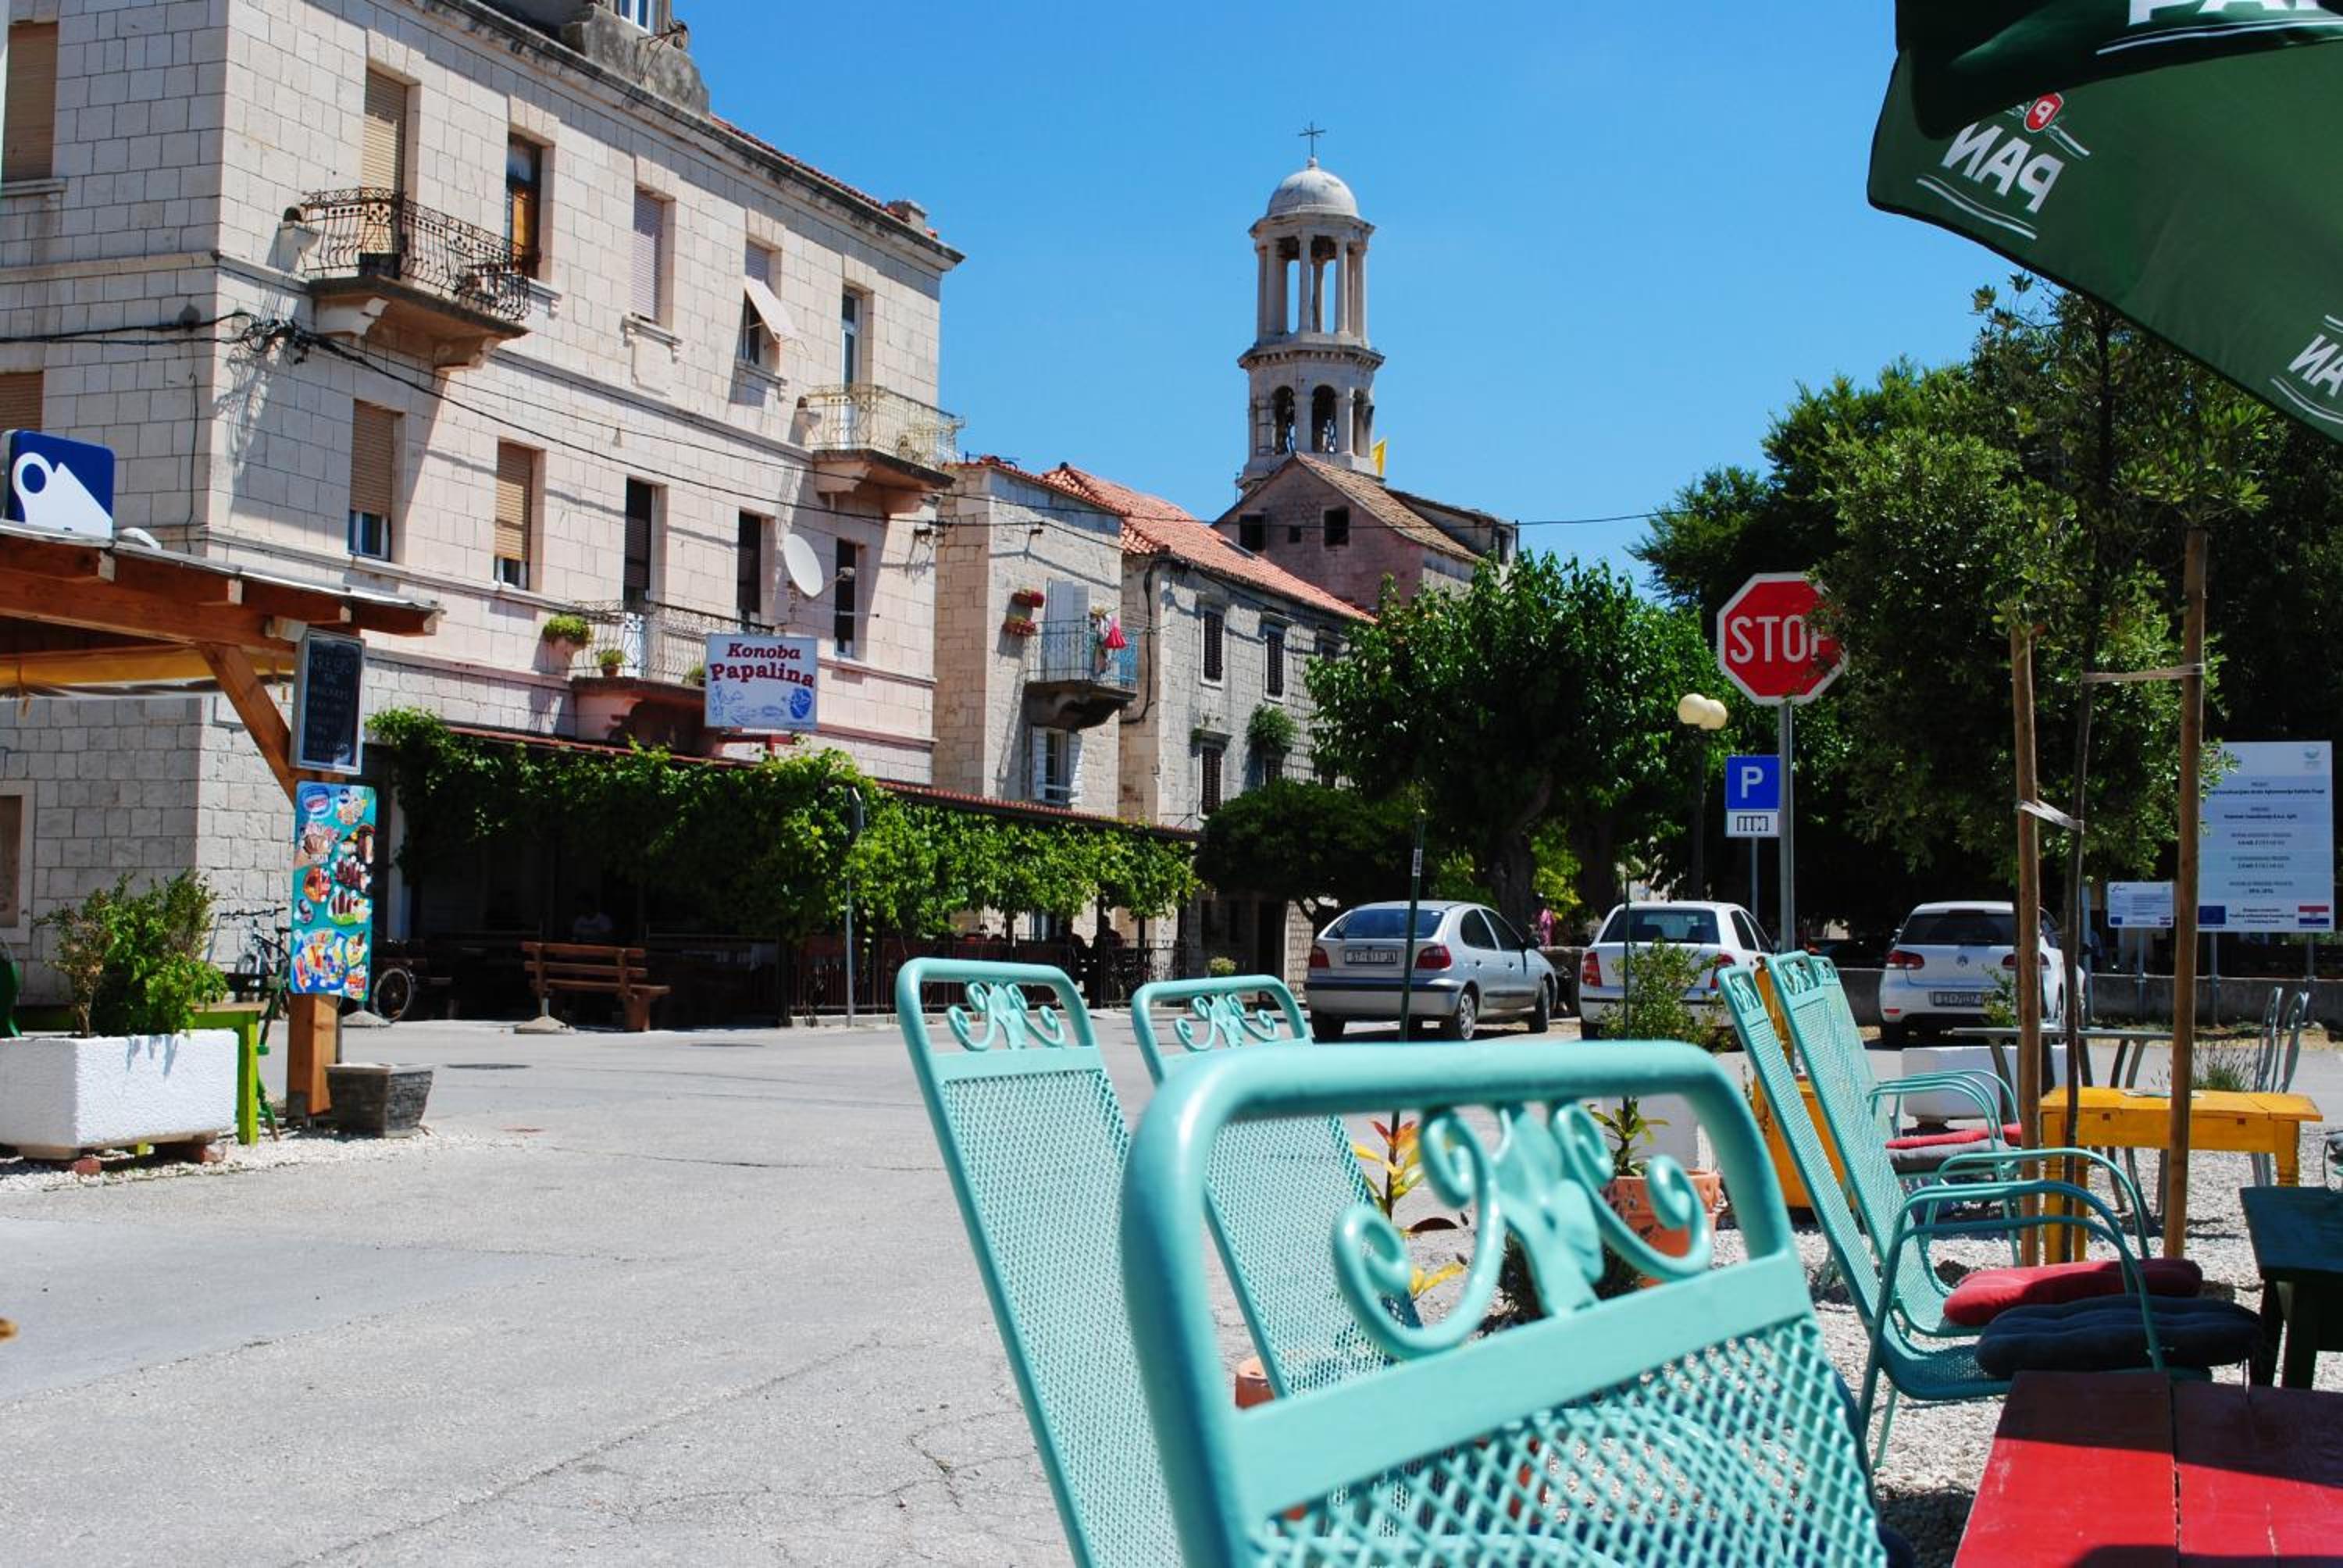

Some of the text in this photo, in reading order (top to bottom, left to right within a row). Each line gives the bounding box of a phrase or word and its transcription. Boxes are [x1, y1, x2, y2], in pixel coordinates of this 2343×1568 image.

[726, 643, 801, 660] Konoba
[709, 662, 815, 688] Papalina
[1740, 765, 1764, 800] P
